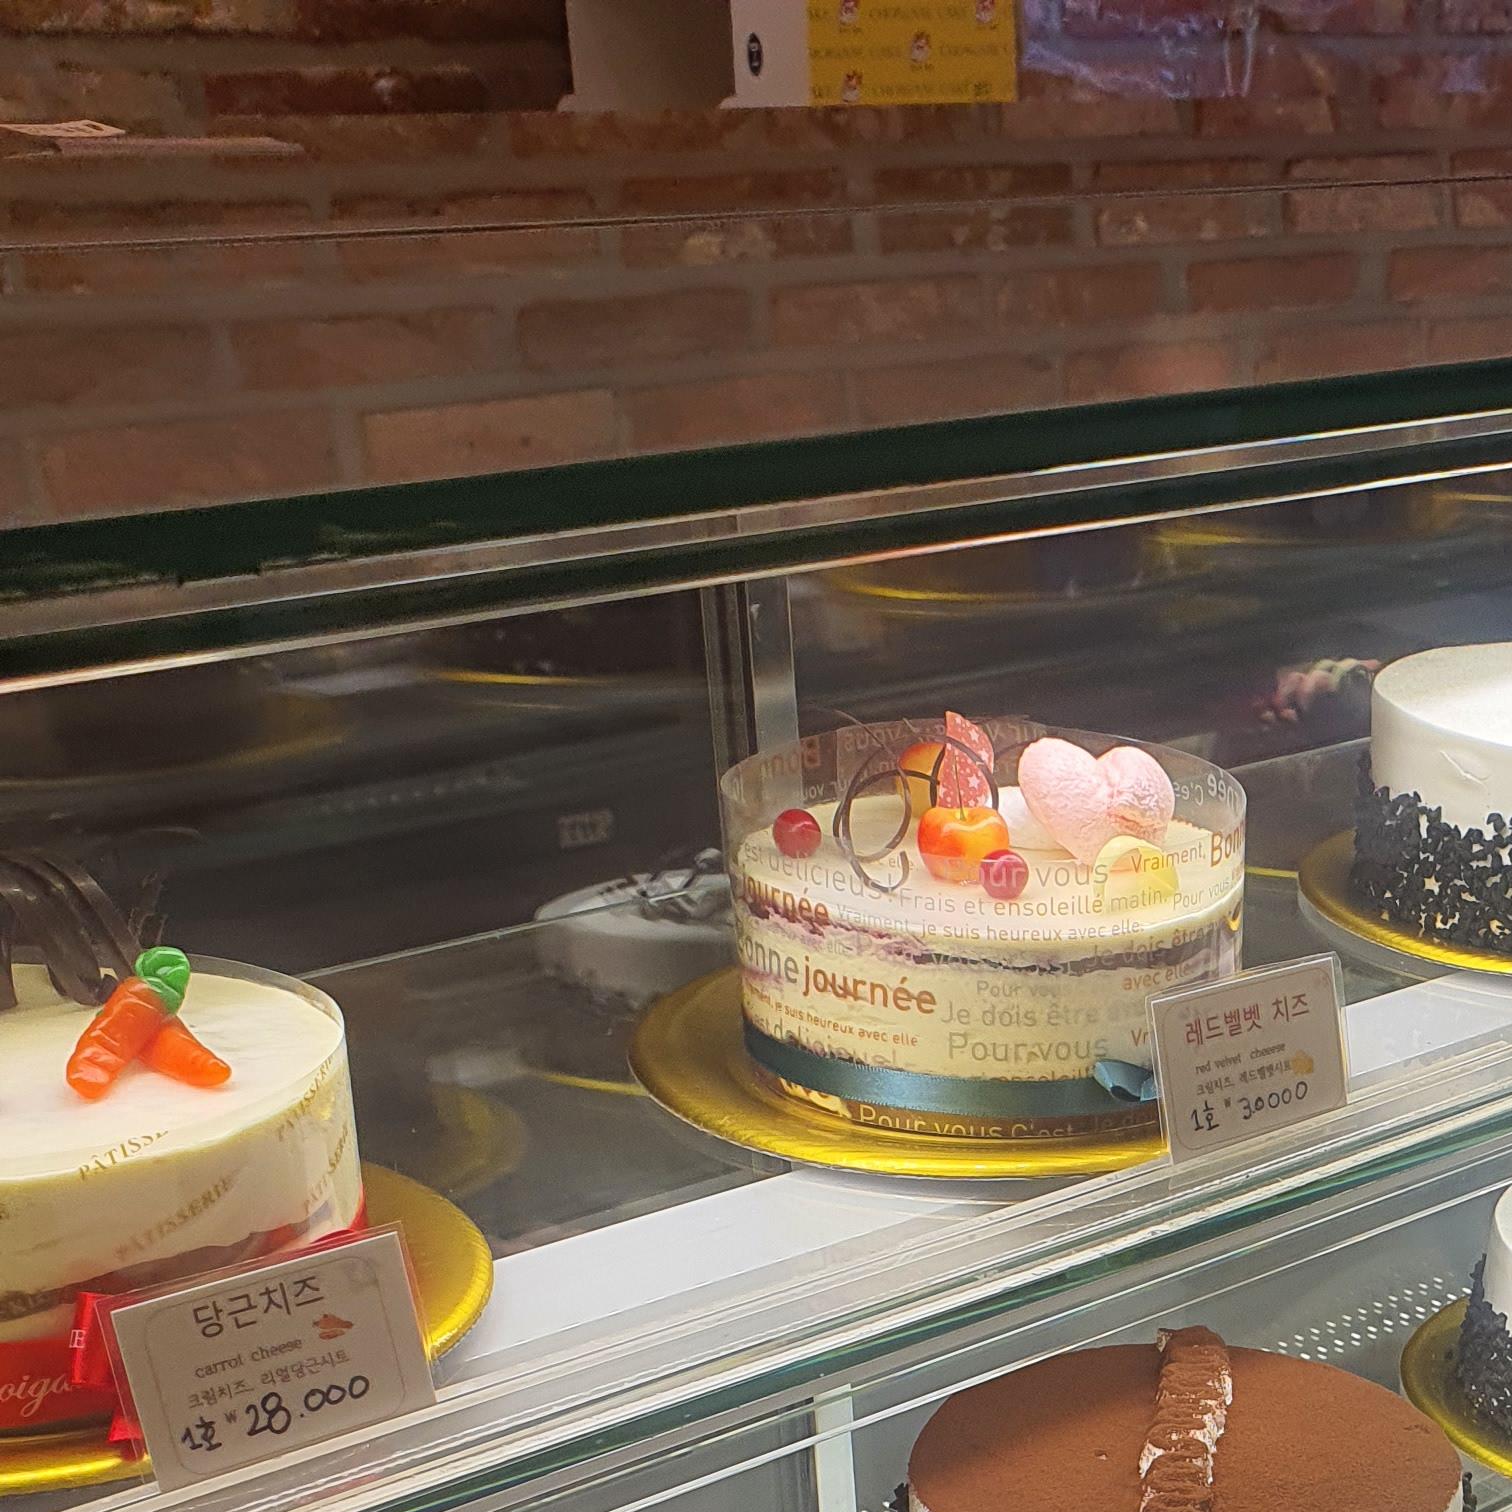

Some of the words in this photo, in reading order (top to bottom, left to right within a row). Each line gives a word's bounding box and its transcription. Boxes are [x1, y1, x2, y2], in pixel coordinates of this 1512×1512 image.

[900, 887, 956, 913] Frais
[964, 897, 986, 916] et
[994, 894, 1103, 917] ensoleillé
[943, 924, 981, 940] suis
[987, 924, 1063, 942] heureux
[1068, 926, 1106, 941] avec
[803, 955, 938, 1014] journée
[858, 1027, 888, 1043] avec
[1185, 1003, 1263, 1046] 레드벨벳
[1273, 993, 1310, 1022] 치즈
[948, 1030, 1028, 1062] Pour
[193, 1276, 325, 1338] 당근치즈
[195, 1354, 244, 1379] carrot
[251, 1339, 303, 1362] cheese
[182, 1417, 223, 1451] 1호
[246, 1375, 370, 1436] 28.000
